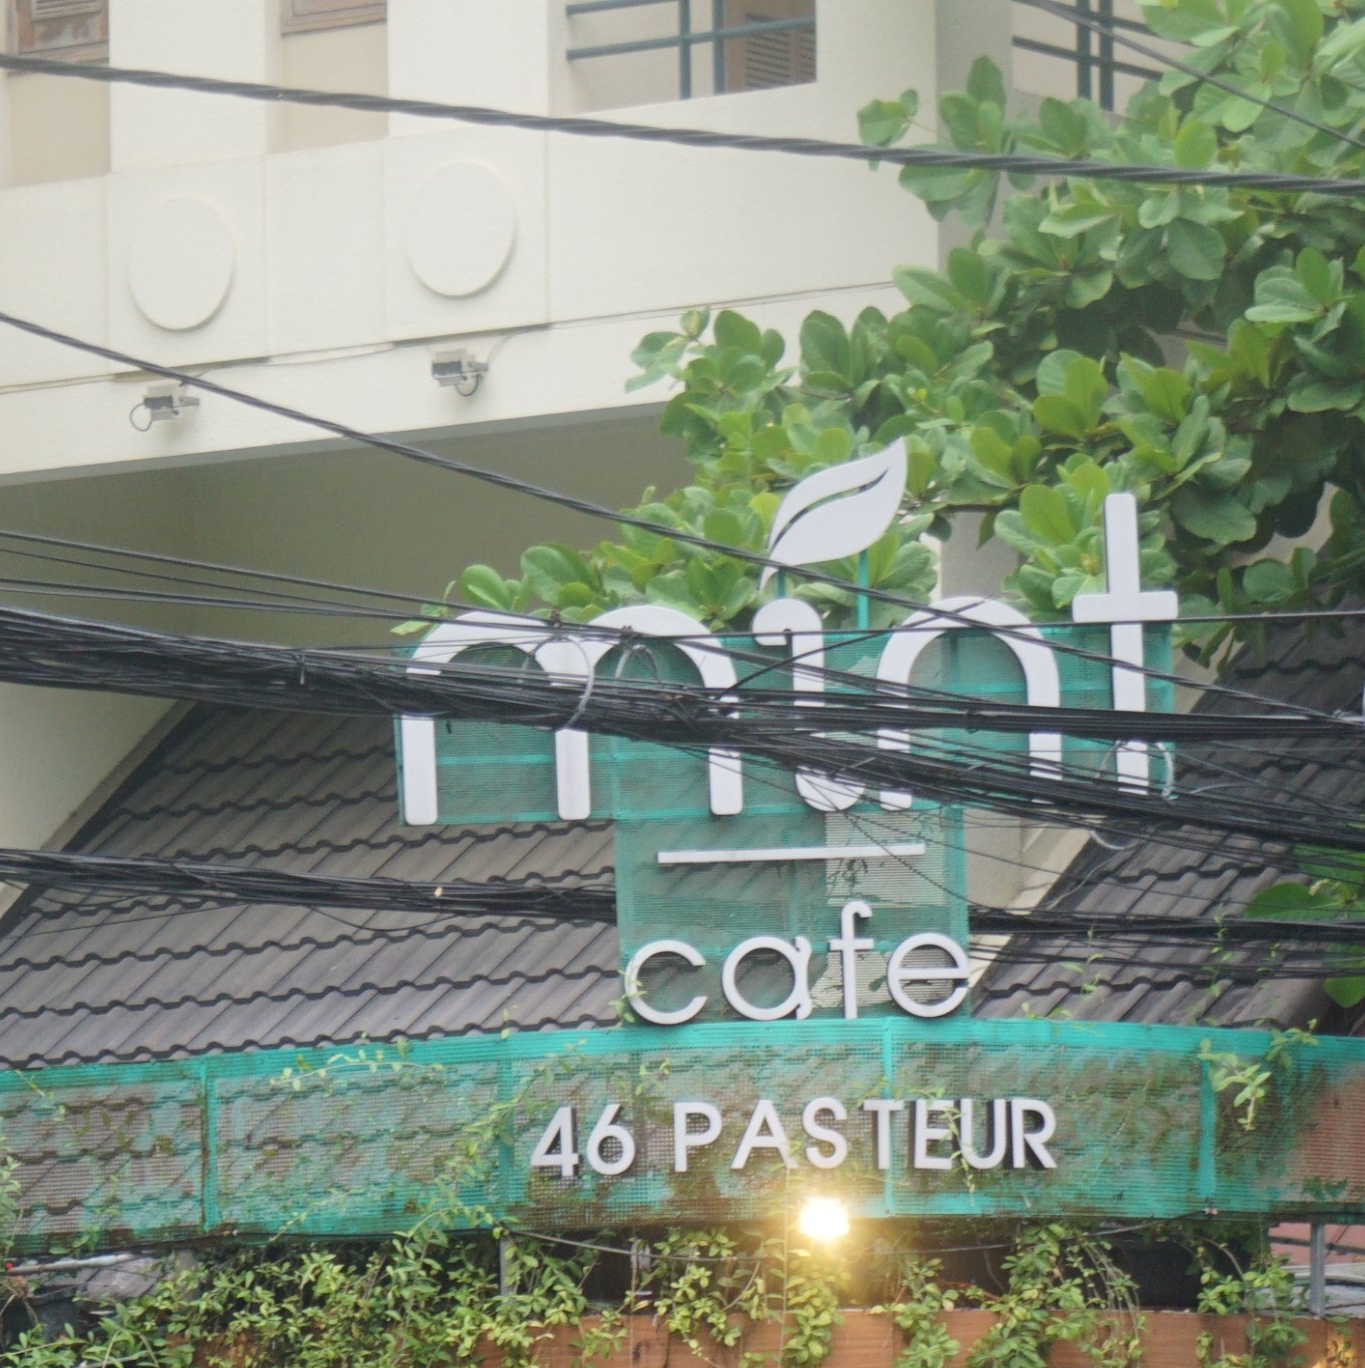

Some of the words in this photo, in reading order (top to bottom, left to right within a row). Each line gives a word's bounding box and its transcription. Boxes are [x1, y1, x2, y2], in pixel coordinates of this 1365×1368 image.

[402, 490, 1180, 827] mint
[624, 900, 972, 1026] cafe
[529, 1102, 636, 1178] 46
[671, 1096, 1059, 1173] PASTEUR
